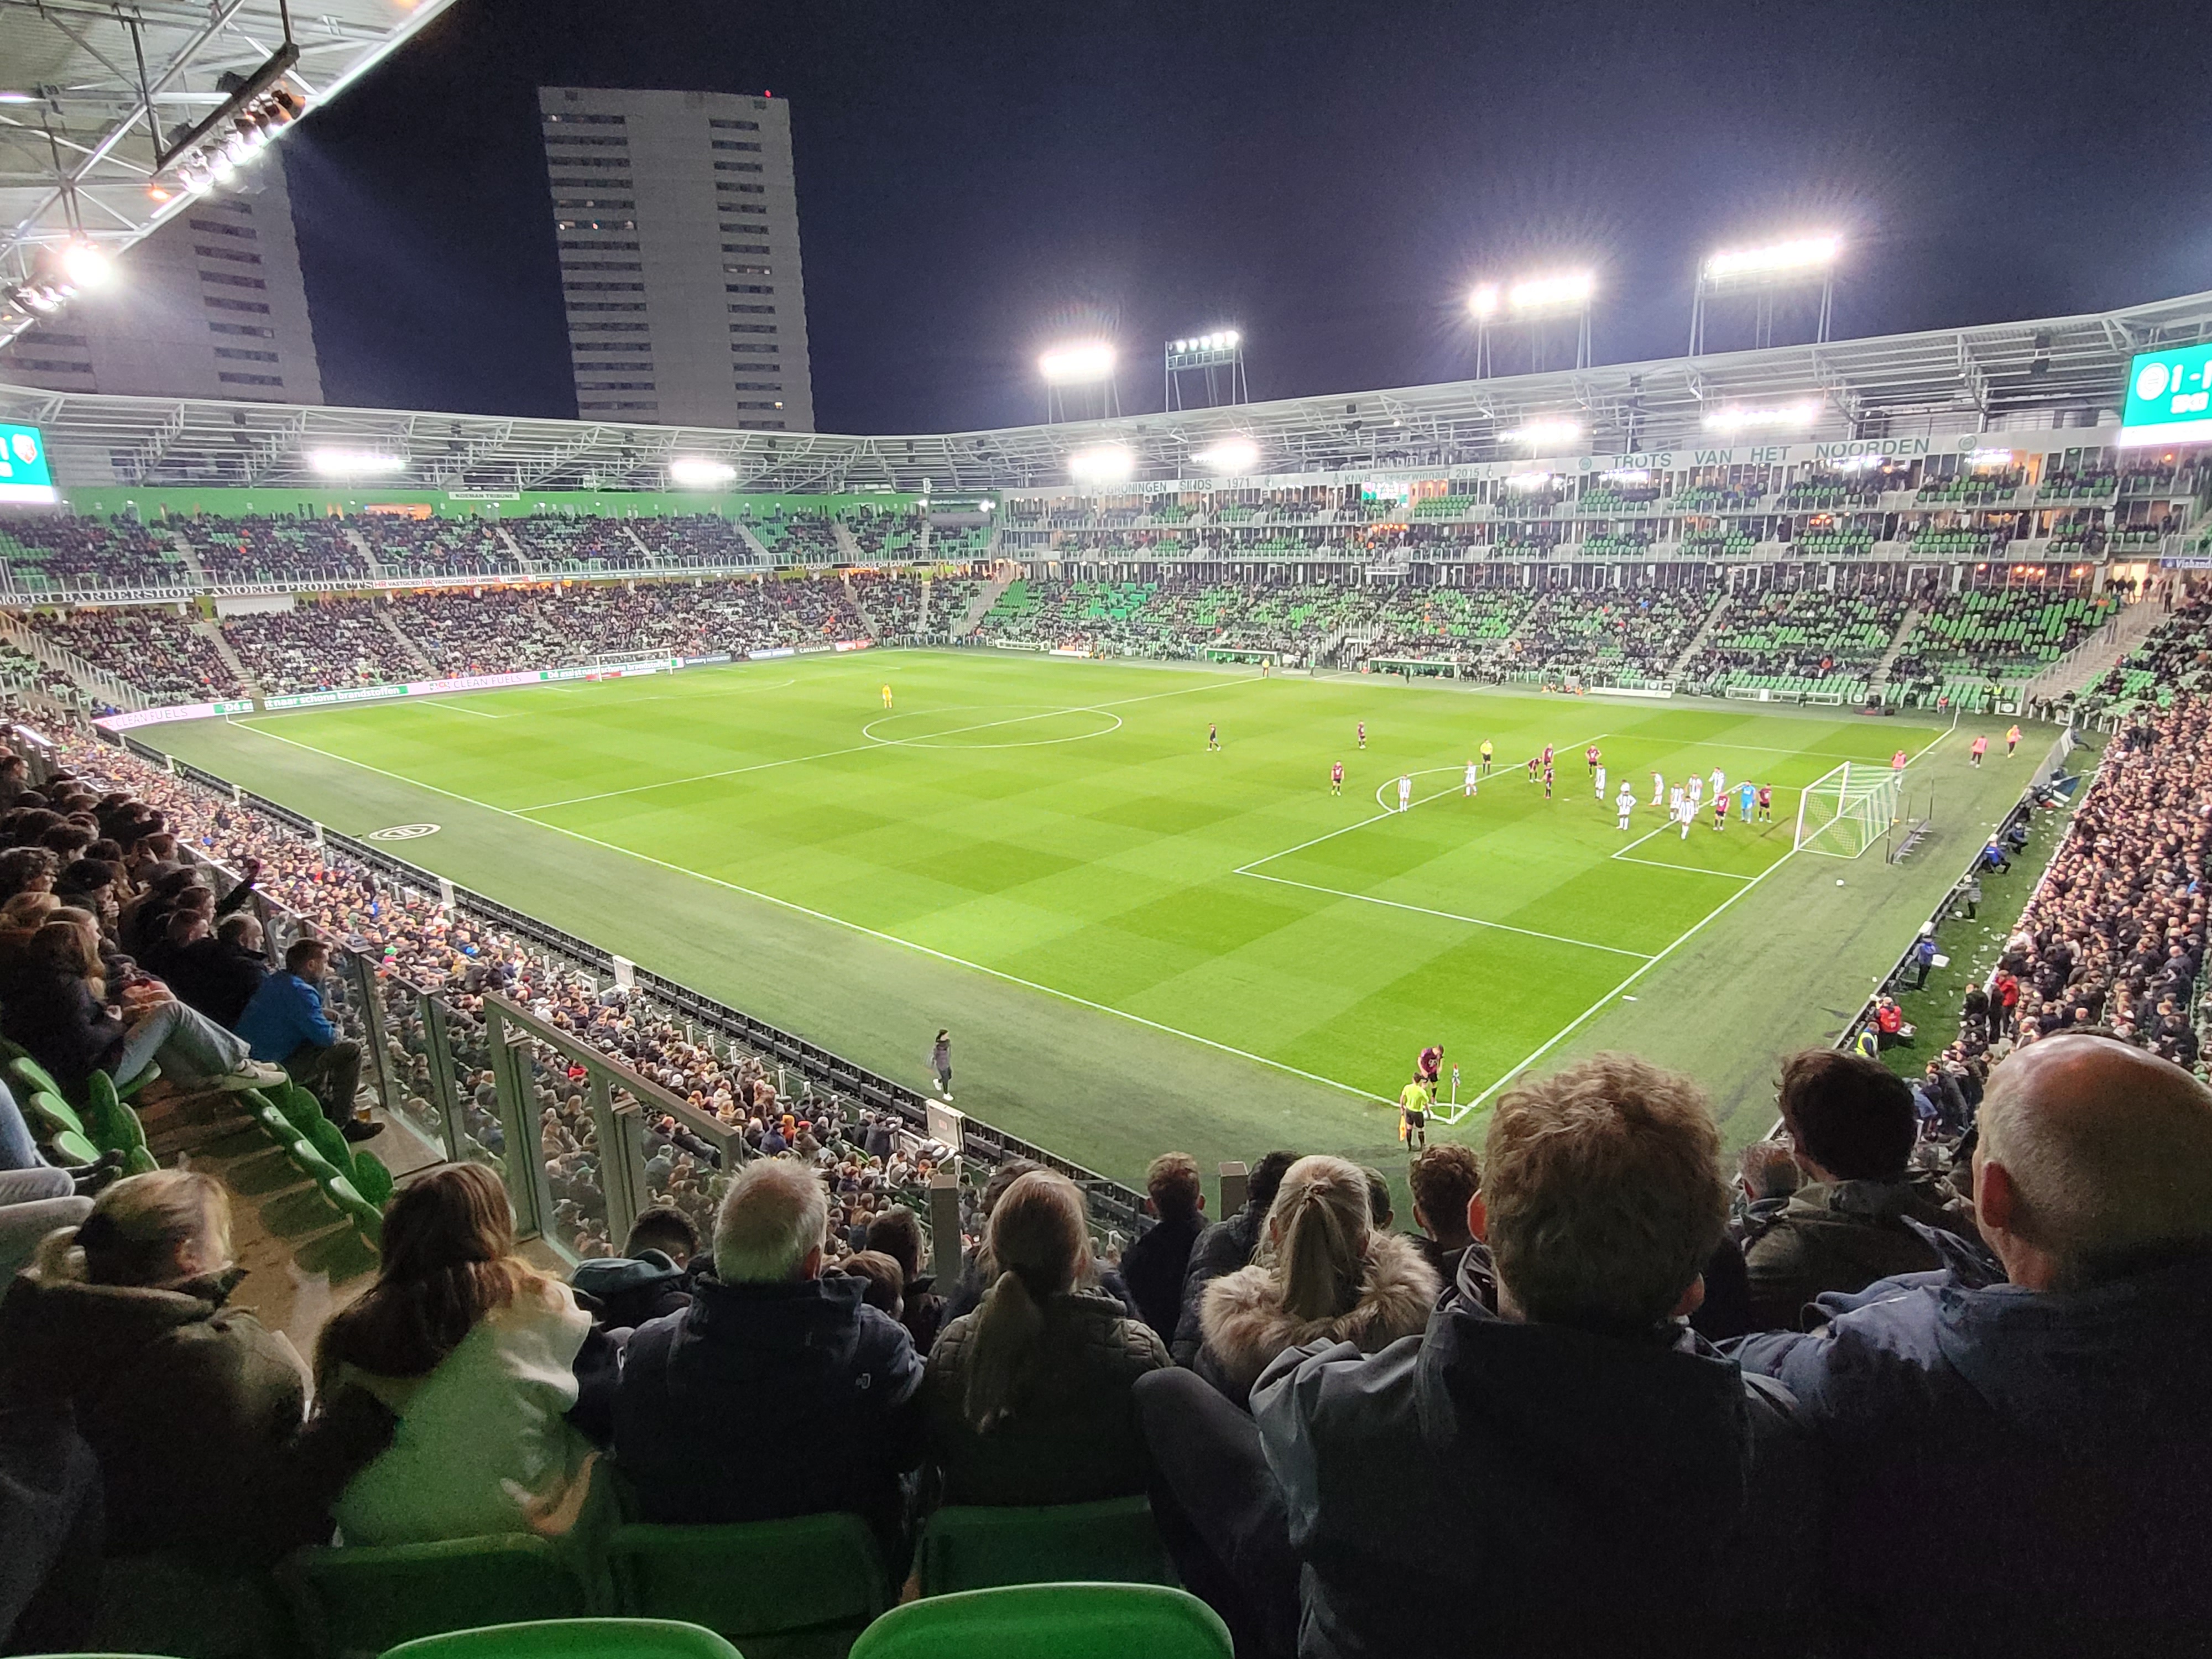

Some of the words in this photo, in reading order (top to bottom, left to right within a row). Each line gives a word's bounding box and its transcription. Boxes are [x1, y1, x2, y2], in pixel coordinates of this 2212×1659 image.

[1612, 452, 1672, 468] TROTS
[1694, 448, 1733, 465] VAN
[1750, 445, 1792, 462] HET
[1815, 437, 1930, 458] NOORDEN
[1344, 473, 1371, 483] KNVB
[1456, 468, 1480, 478] 2015
[1091, 484, 1103, 495] FC
[1107, 482, 1167, 494] GRONINGEN
[1180, 478, 1212, 491] SINDS
[1226, 477, 1250, 488] 1971
[285, 581, 374, 592] PRODUCTS
[62, 587, 205, 602] BARBERSHOPS
[799, 645, 831, 654] CAVALLARO
[453, 677, 488, 688] CLEAN
[491, 674, 522, 685] FUELS
[547, 670, 560, 679] Dé
[274, 697, 298, 707] naar
[300, 692, 336, 704] schone
[337, 685, 400, 700] brandstoffen
[115, 714, 148, 727] CLEAN
[150, 708, 188, 721] FUELS
